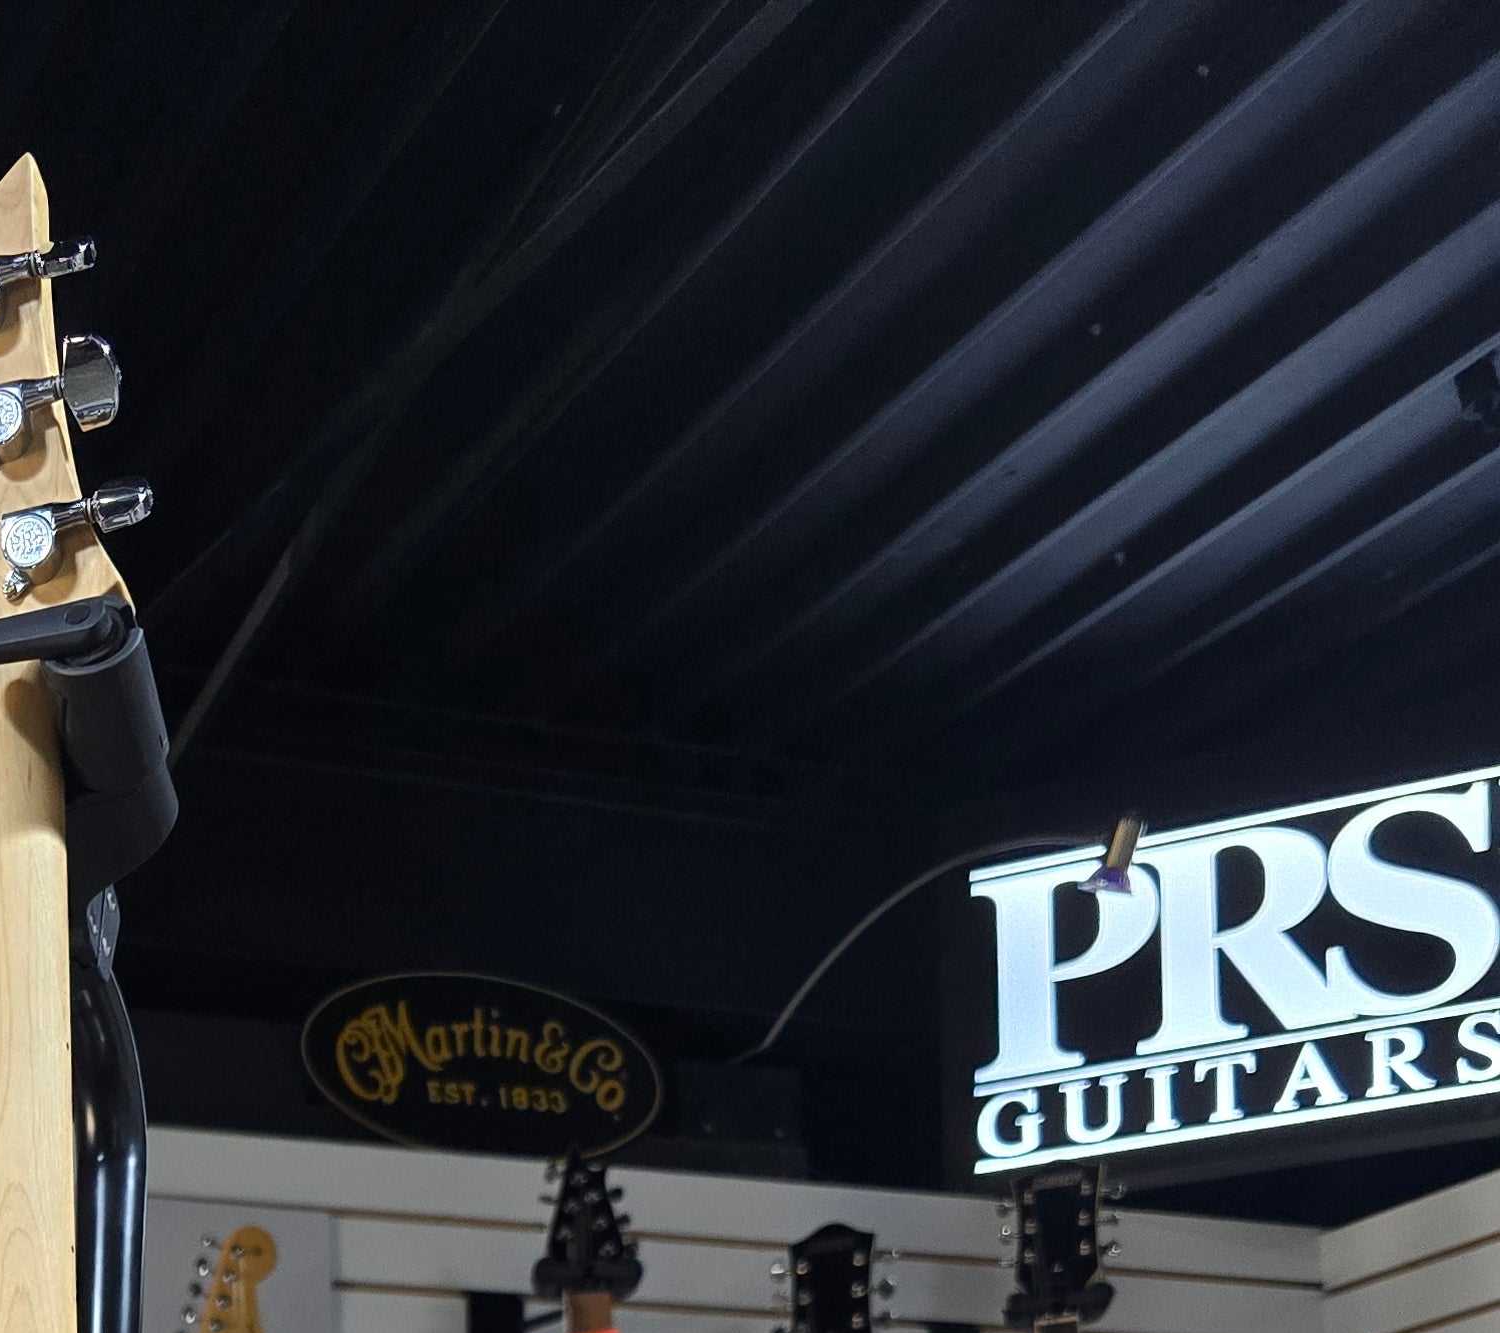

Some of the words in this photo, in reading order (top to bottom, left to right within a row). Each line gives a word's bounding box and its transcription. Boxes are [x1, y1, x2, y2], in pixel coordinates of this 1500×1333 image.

[970, 778, 1500, 1084] PRS
[426, 1079, 490, 1107] EST.
[499, 1084, 568, 1114] 1833
[976, 1008, 1500, 1159] GUITARS
